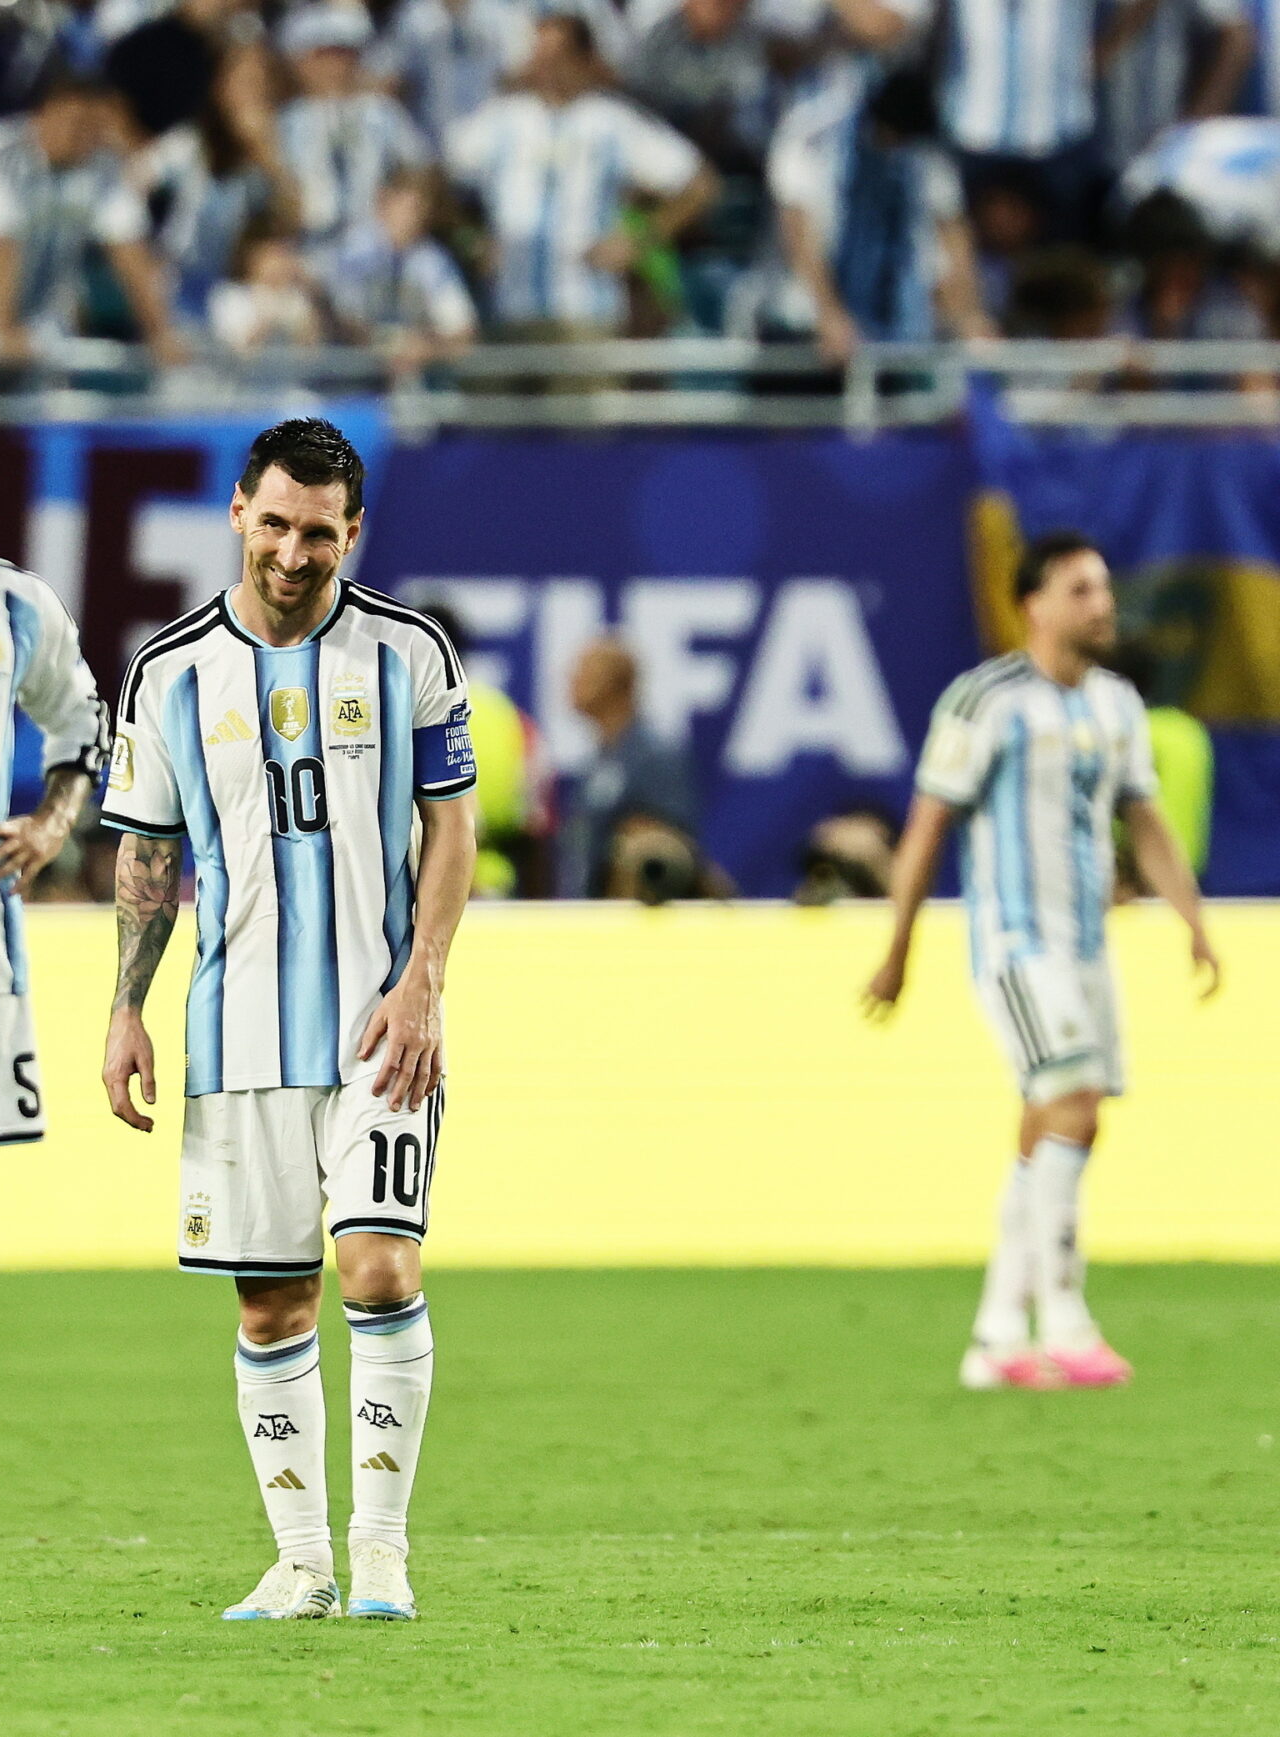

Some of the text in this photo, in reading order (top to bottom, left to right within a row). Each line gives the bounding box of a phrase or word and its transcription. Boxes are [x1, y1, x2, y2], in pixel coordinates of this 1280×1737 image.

[338, 699, 363, 722] AFA
[445, 753, 462, 766] the
[264, 756, 329, 835] 10
[369, 1130, 421, 1207] 10
[253, 1413, 300, 1441] AFA
[357, 1398, 403, 1429] AFA
